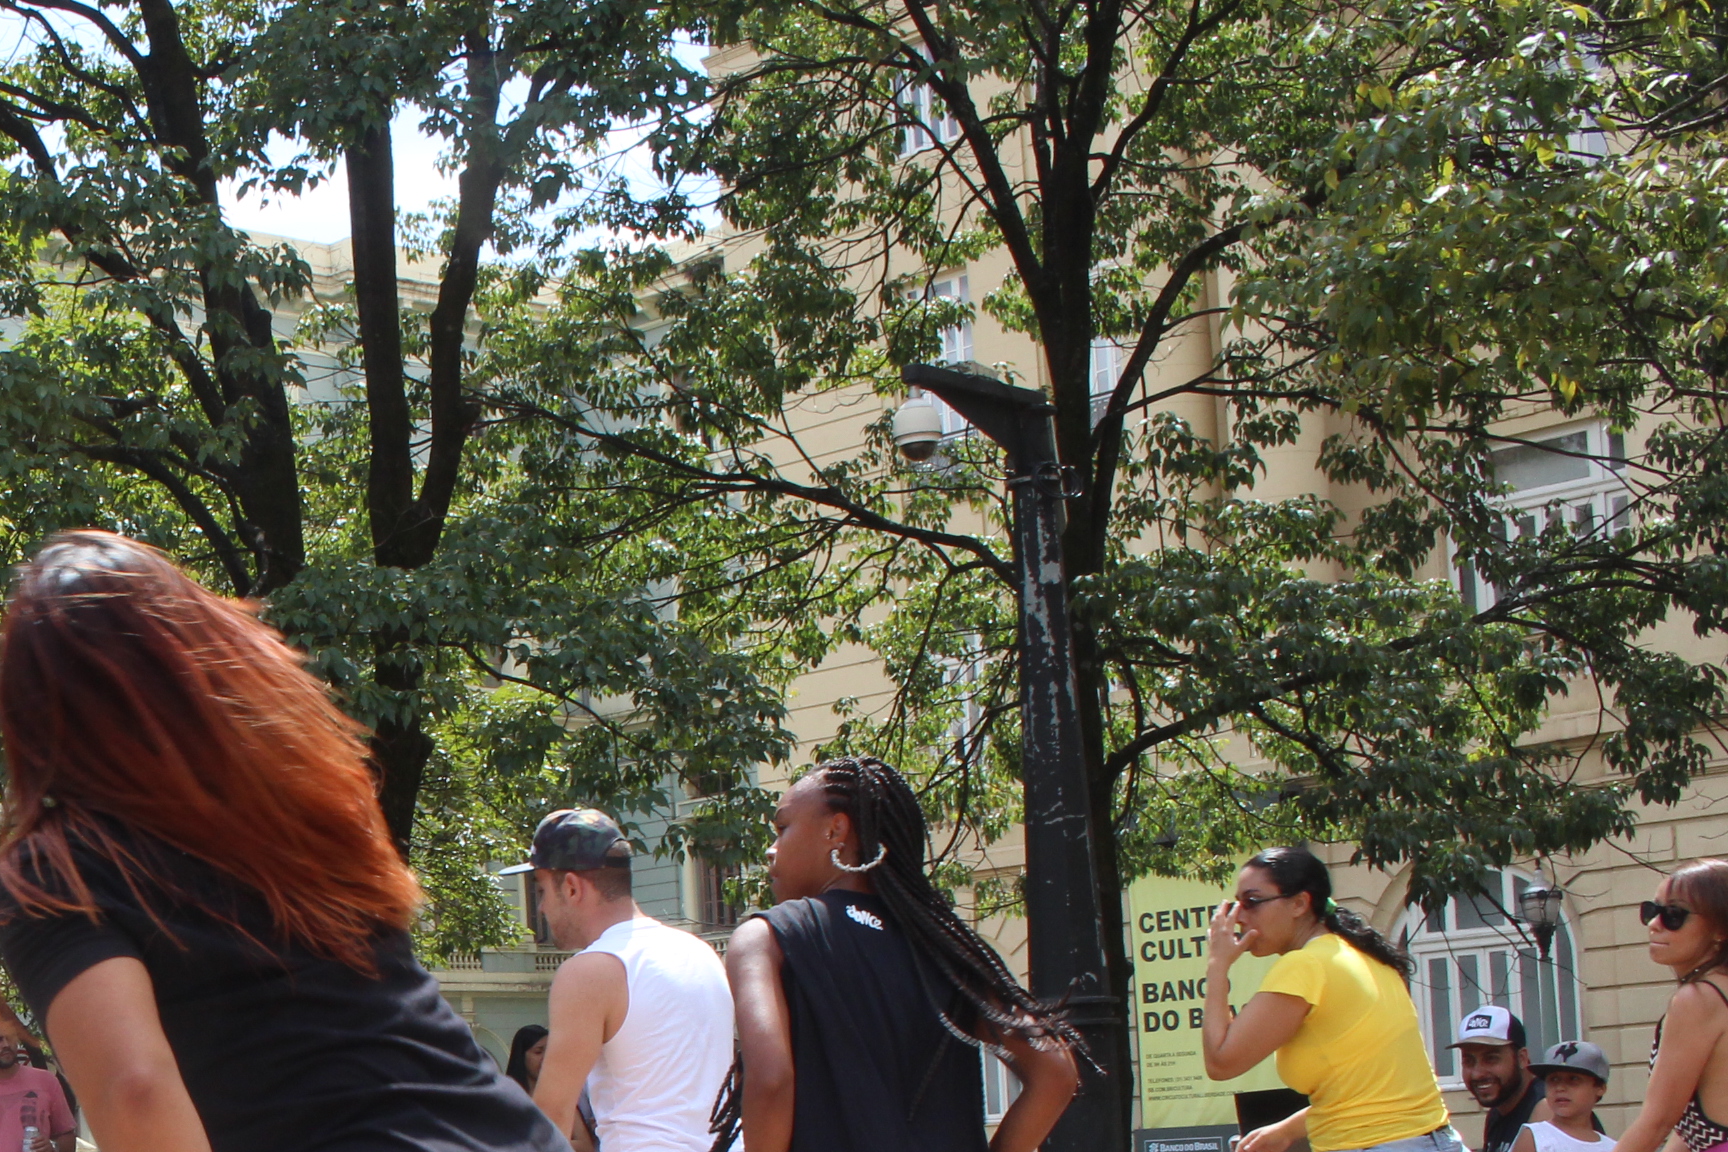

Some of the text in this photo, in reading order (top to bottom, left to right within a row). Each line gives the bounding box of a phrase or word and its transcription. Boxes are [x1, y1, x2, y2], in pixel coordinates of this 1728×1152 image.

[1142, 977, 1230, 1004] BANC
[1143, 1009, 1180, 1033] DO
[1160, 1143, 1184, 1152] BANCO
[1194, 1141, 1218, 1151] BRASIL
